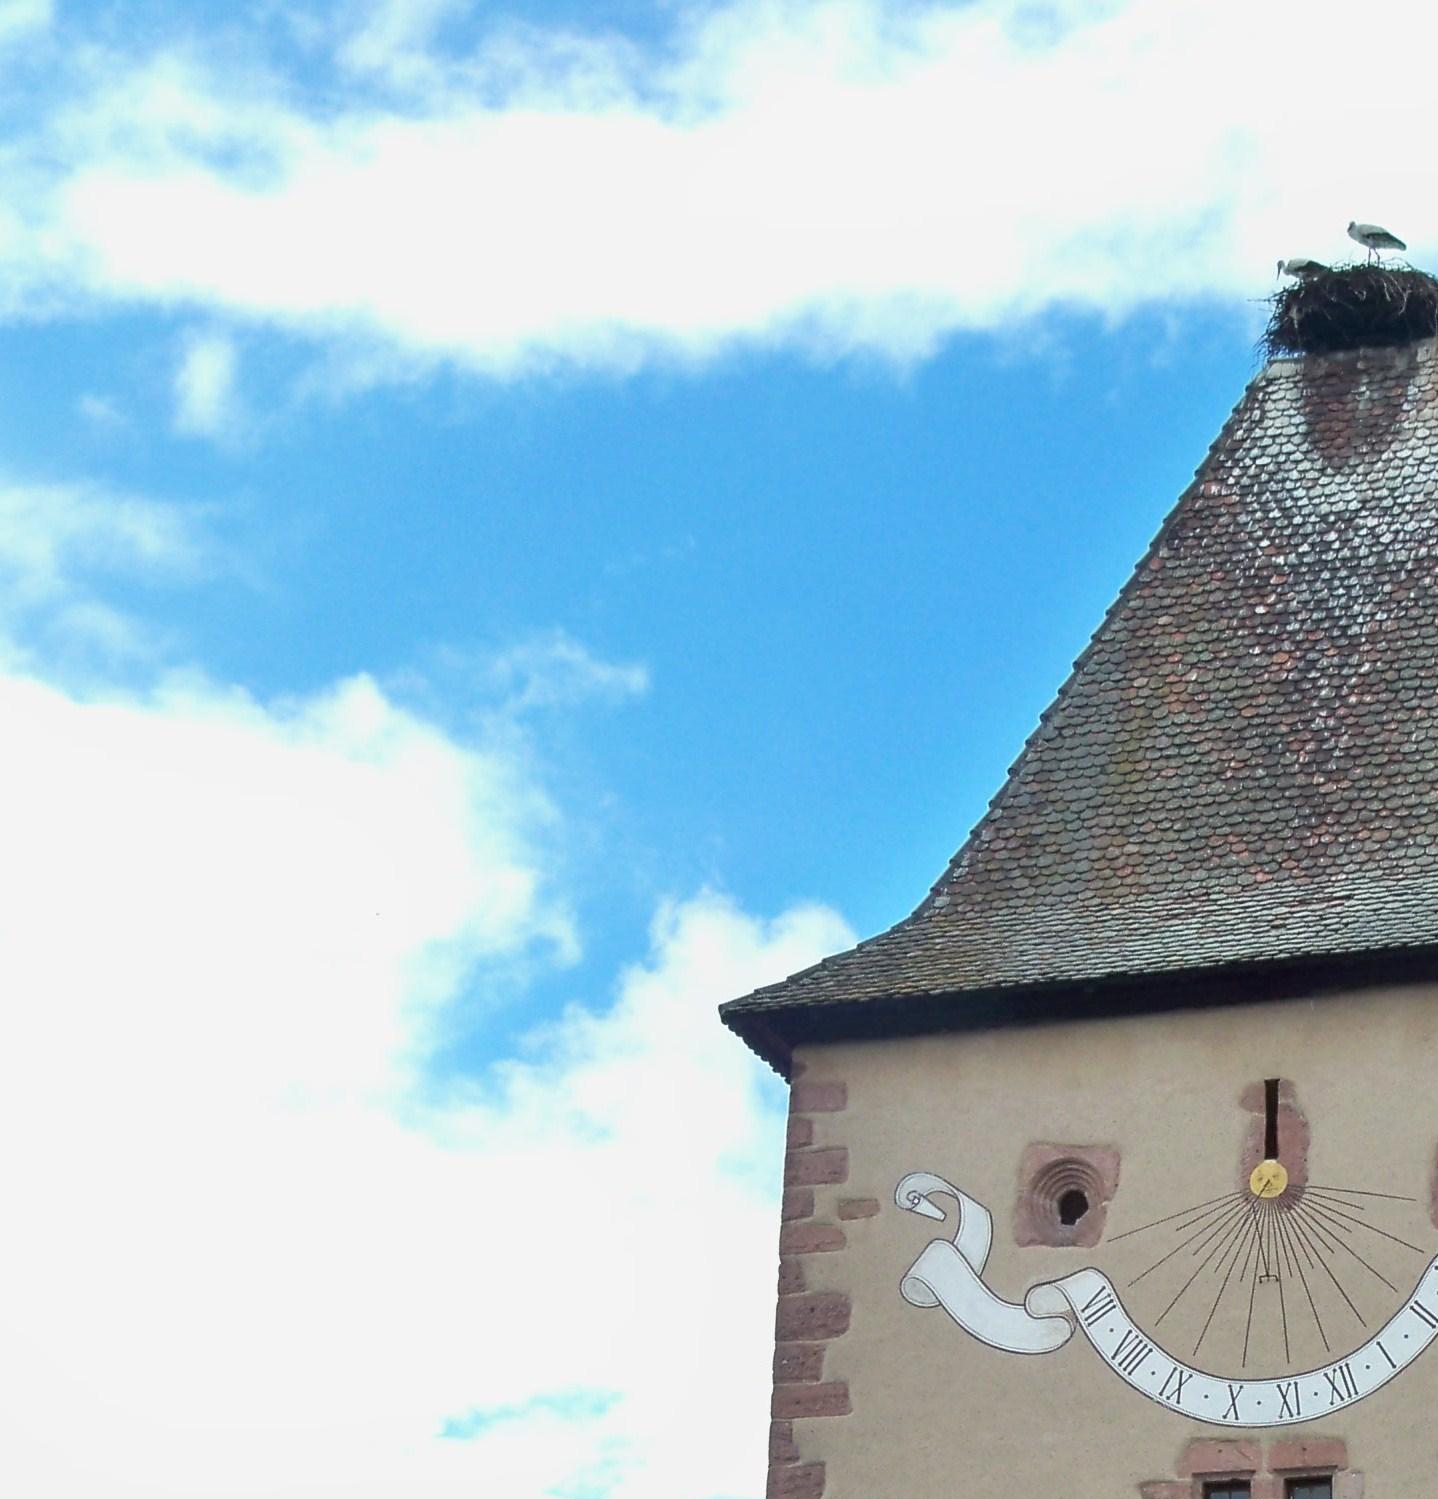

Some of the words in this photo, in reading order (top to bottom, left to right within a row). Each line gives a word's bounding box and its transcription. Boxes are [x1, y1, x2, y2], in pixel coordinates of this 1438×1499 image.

[1081, 1286, 1117, 1328] VII
[1111, 1329, 1154, 1376] VIII
[1158, 1366, 1194, 1405] IX
[1221, 1383, 1245, 1421] X
[1277, 1381, 1302, 1419] XI
[1323, 1363, 1359, 1406] XII
